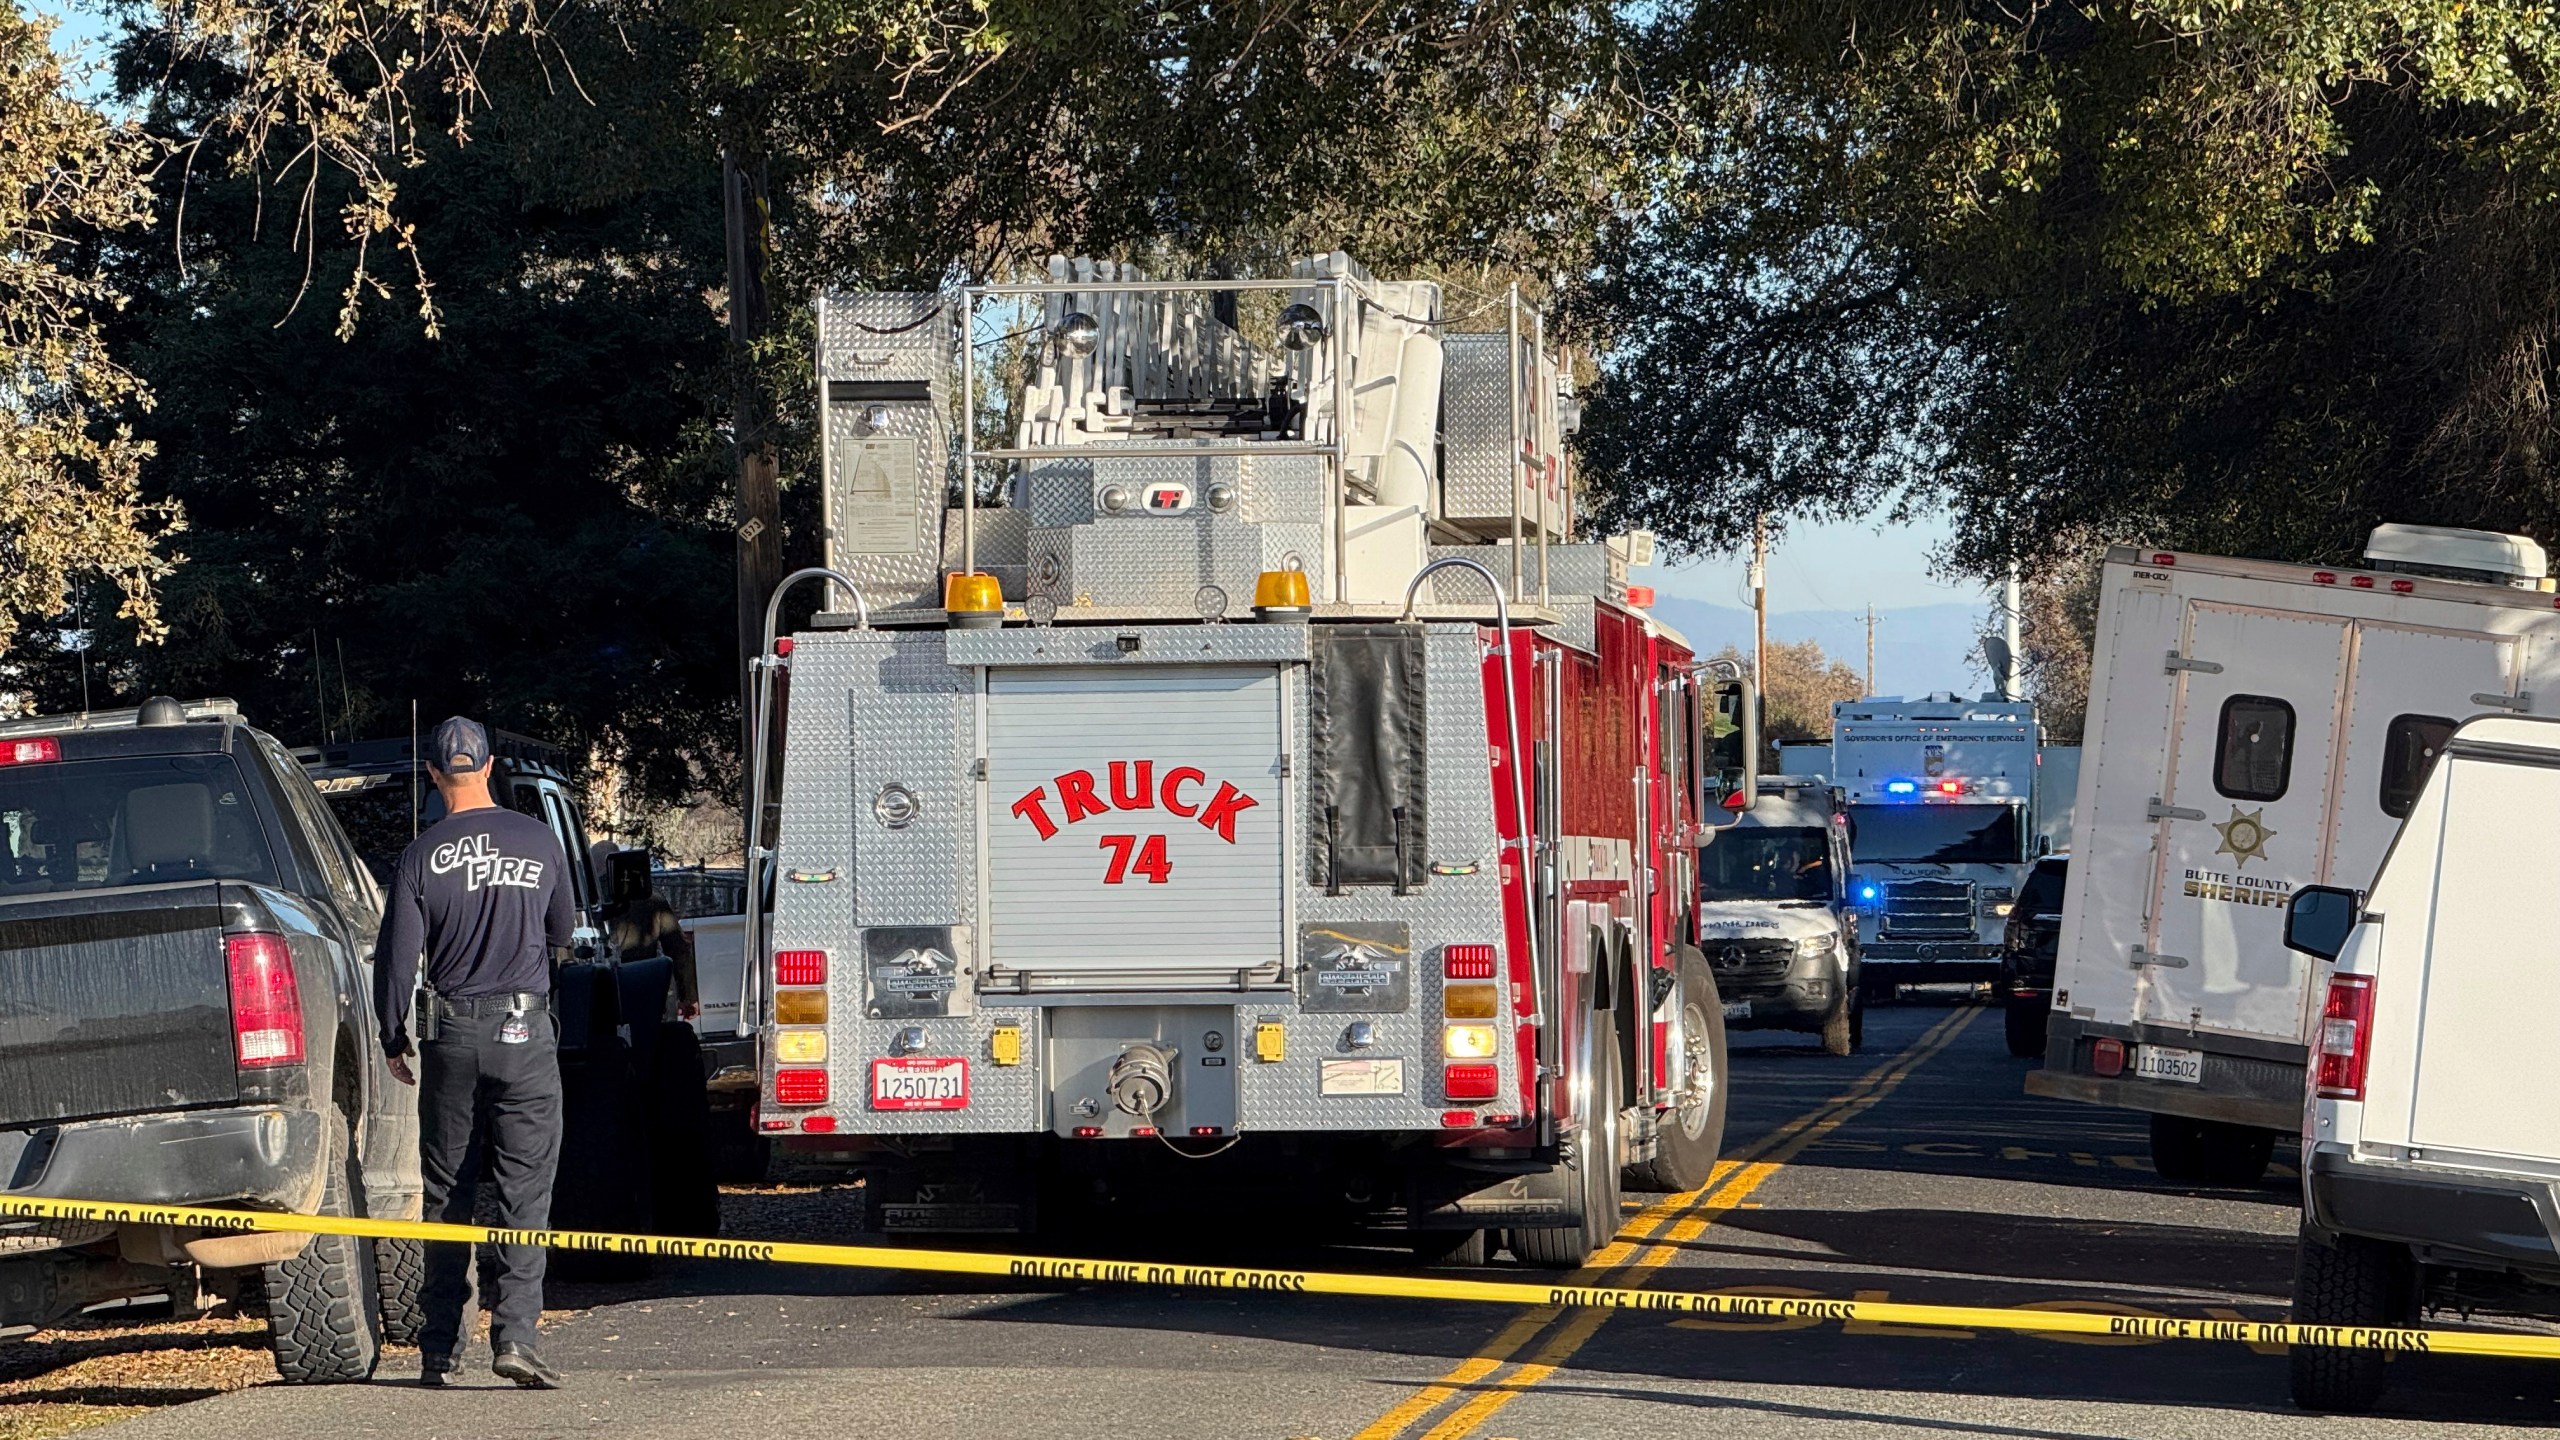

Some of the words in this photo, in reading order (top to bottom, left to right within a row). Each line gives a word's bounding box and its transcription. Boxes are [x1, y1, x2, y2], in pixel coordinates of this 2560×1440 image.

[1844, 735, 1893, 743] GOVERNOR'S
[1895, 735, 1921, 743] OFFICE
[1923, 735, 1934, 743] OF
[1936, 735, 1984, 743] EMERGENCY
[1986, 735, 2025, 743] SERVICES
[1011, 760, 1259, 844] TRUCK
[431, 833, 499, 874] CAL
[1099, 835, 1173, 884] 74
[468, 857, 543, 891] FIRE
[2185, 869, 2229, 884] BUTTE
[2237, 876, 2293, 891] COUNTY
[2184, 881, 2290, 909] SHERIFF
[2140, 1056, 2197, 1078] 1103502
[881, 1076, 962, 1099] 1250731
[656, 1240, 697, 1256] NOT
[1183, 1269, 1226, 1288] NOT
[1729, 1298, 1774, 1315] NOT
[2298, 1326, 2343, 1347] NOT
